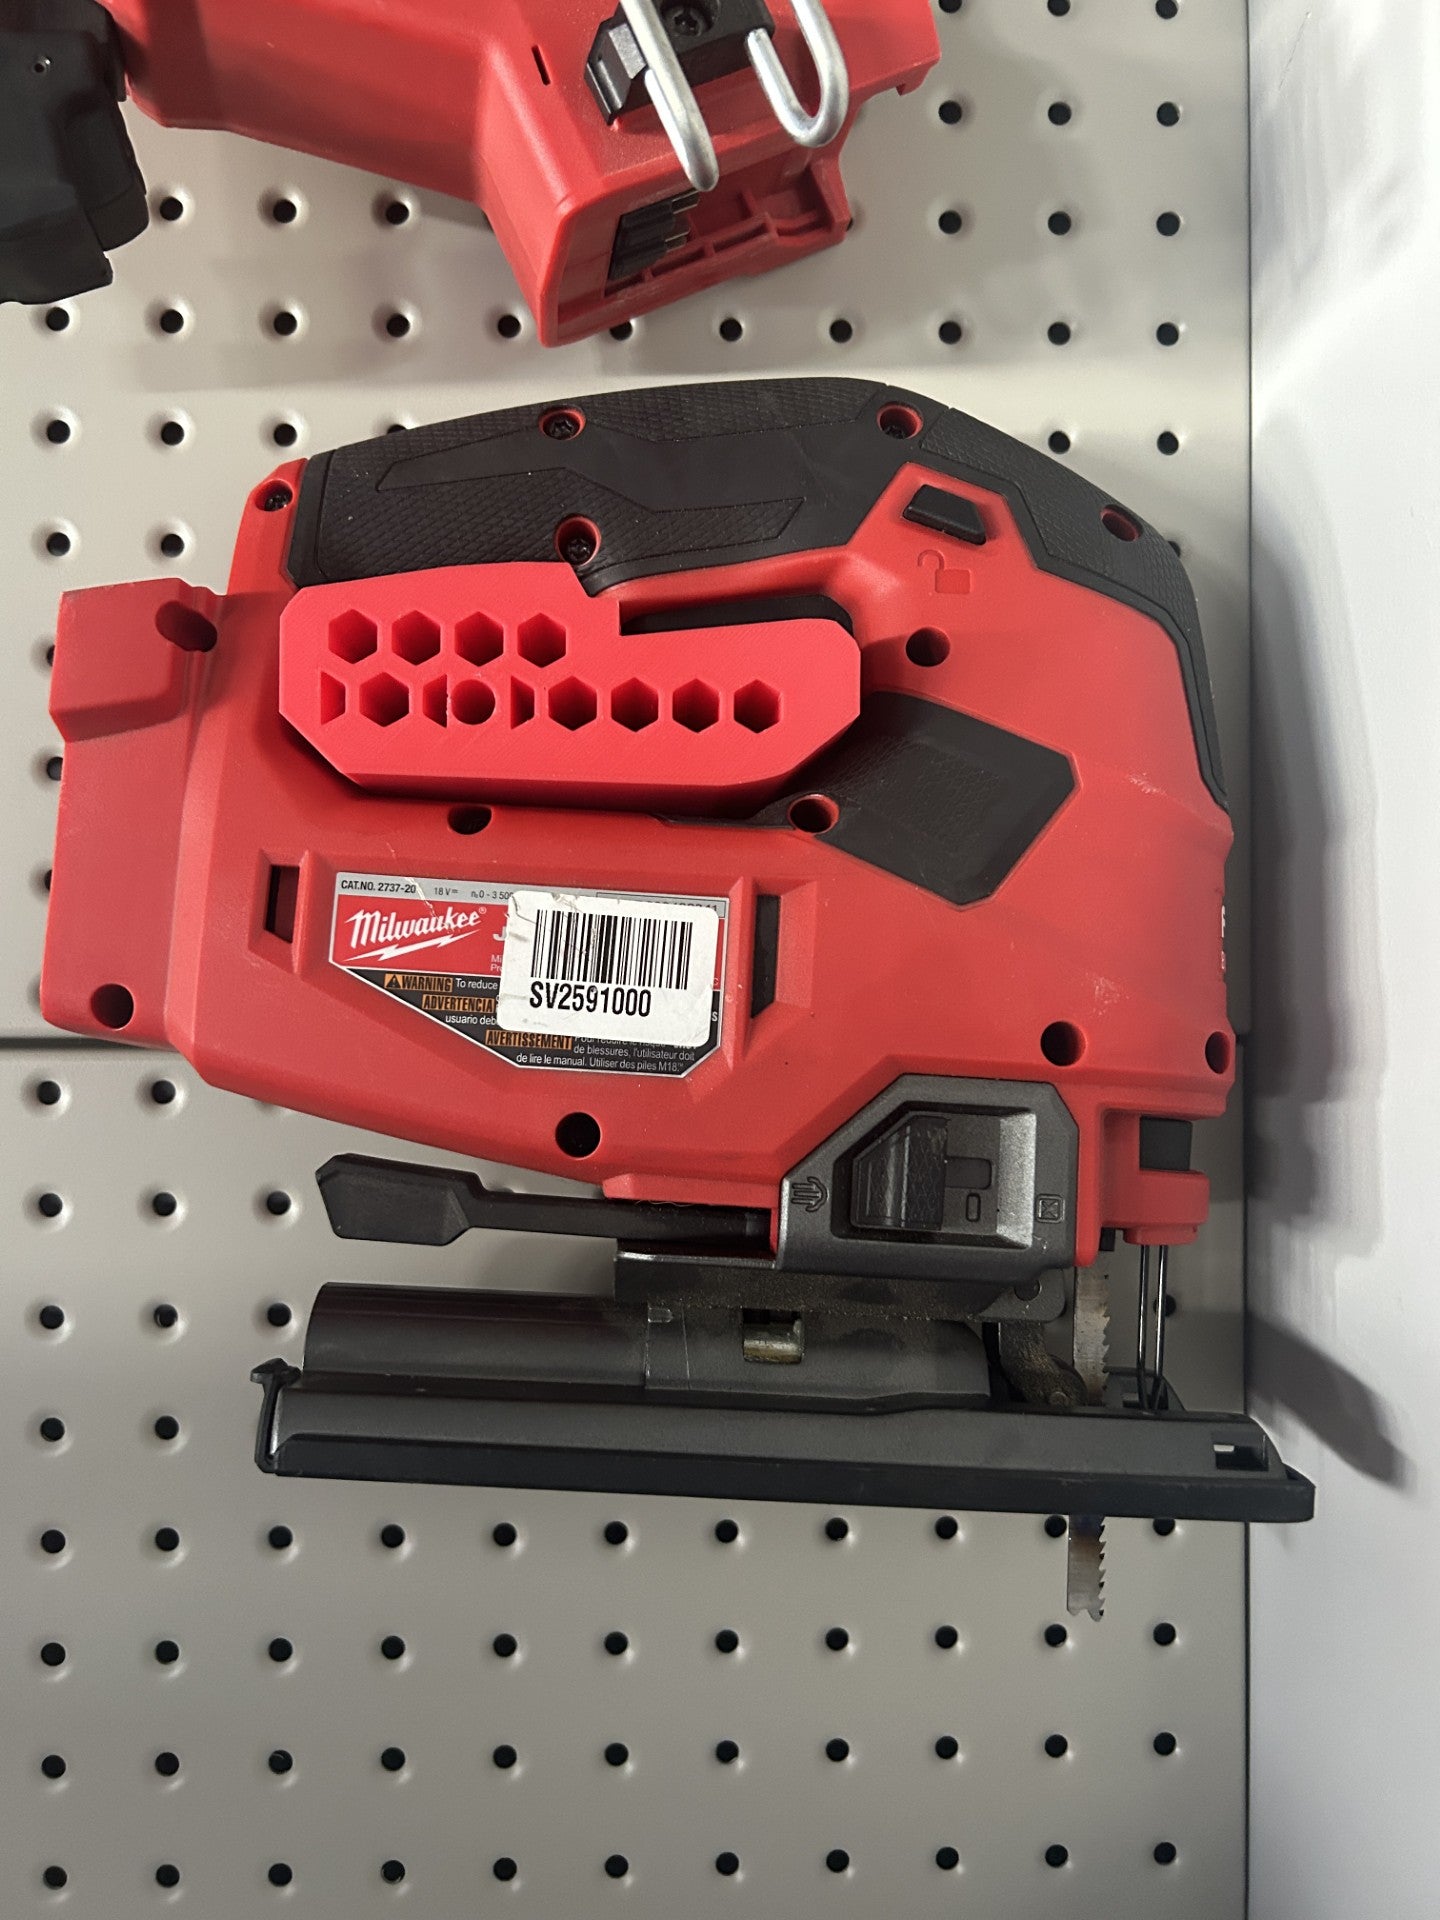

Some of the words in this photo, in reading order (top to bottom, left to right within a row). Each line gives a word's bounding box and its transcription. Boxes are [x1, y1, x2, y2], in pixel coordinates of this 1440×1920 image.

[341, 880, 376, 891] CAT.NO.
[378, 882, 417, 894] 2737-20
[434, 887, 444, 896] 18
[401, 975, 452, 991] WARNING
[455, 978, 466, 988] To
[468, 979, 498, 989] reduce
[423, 995, 493, 1012] ADVERTENCIA
[529, 981, 652, 1017] SV2591000
[445, 1014, 478, 1024] usuario
[479, 1015, 498, 1025] deb
[486, 1031, 571, 1048] AVERTISSEMENT
[573, 1045, 585, 1053] de
[586, 1045, 630, 1058] blessures,
[678, 1051, 695, 1061] doit
[516, 1053, 527, 1063] de
[529, 1053, 542, 1064] lire
[543, 1054, 552, 1064] le
[553, 1056, 587, 1066] manual.
[589, 1057, 619, 1068] Utiliser
[620, 1060, 635, 1069] des
[636, 1061, 657, 1071] piles
